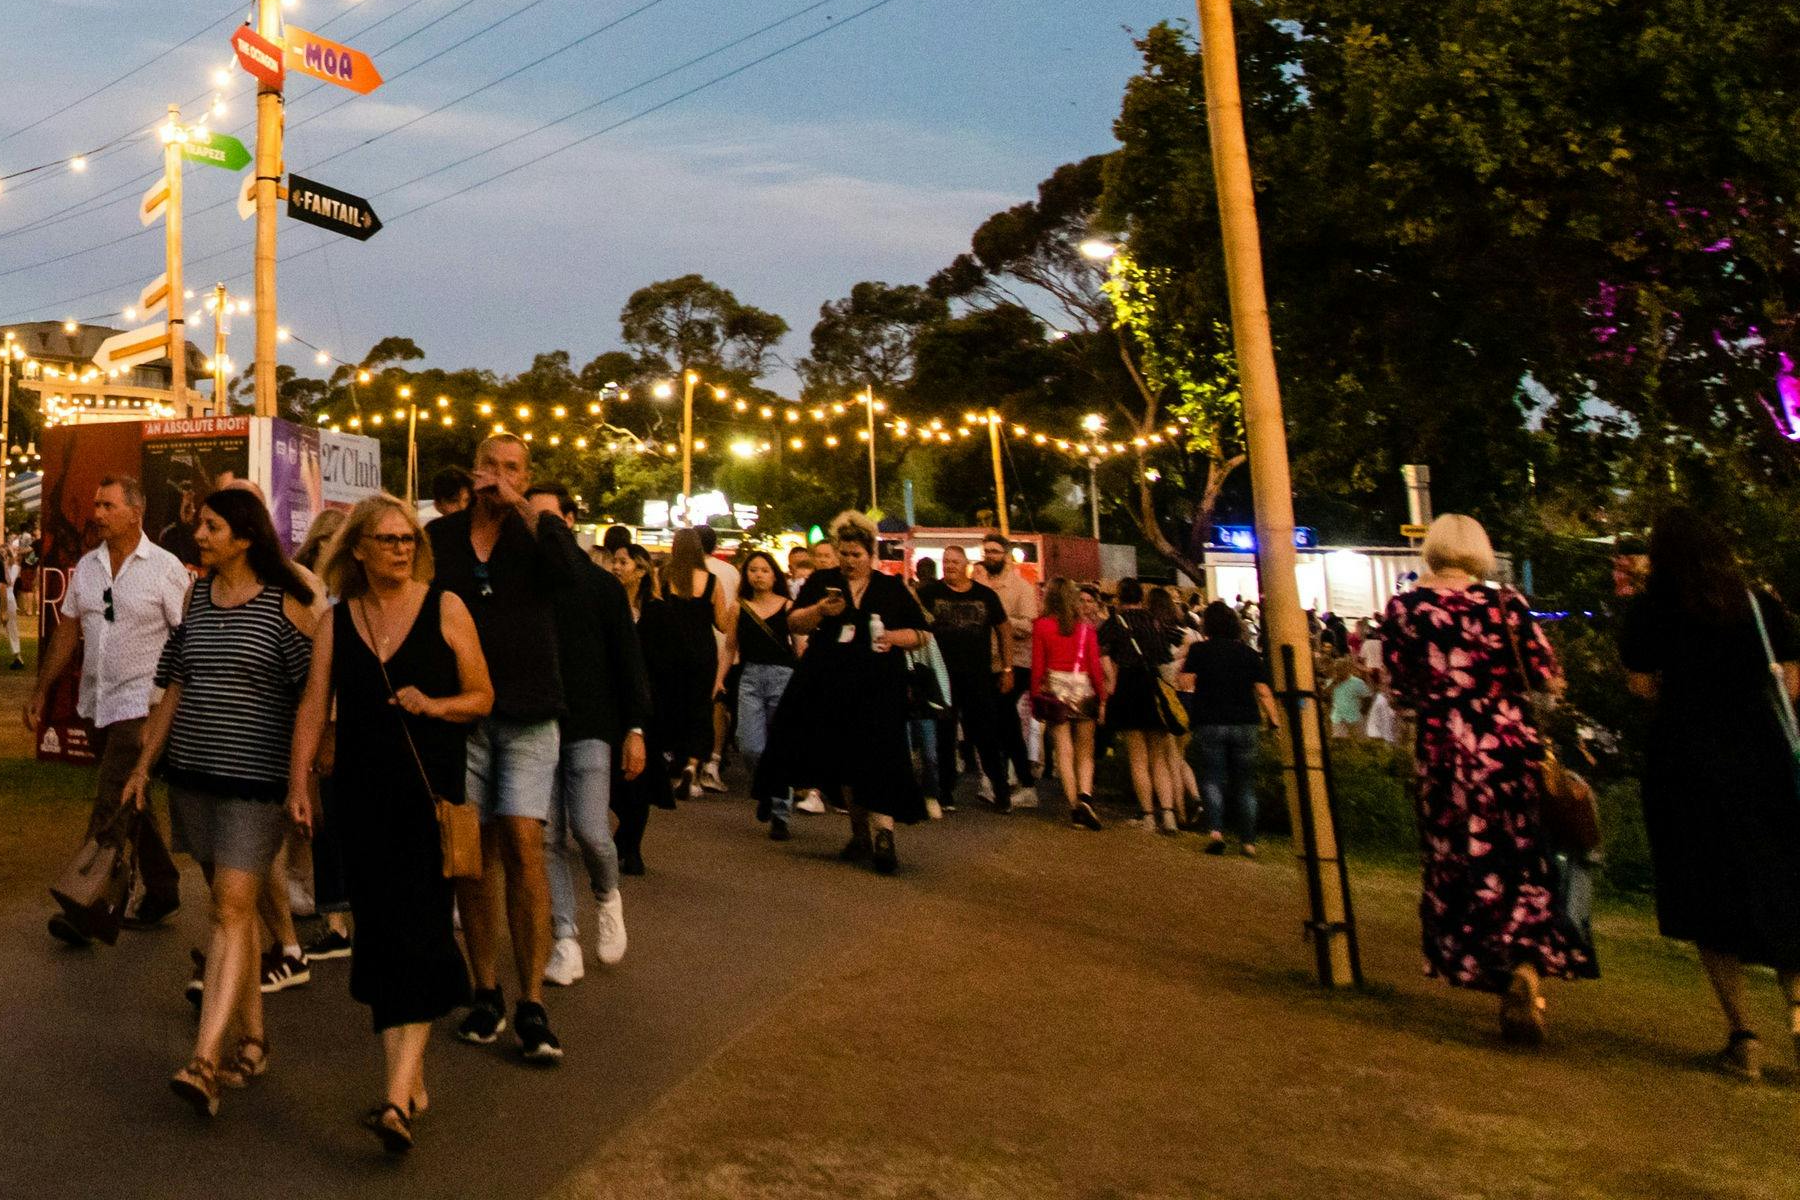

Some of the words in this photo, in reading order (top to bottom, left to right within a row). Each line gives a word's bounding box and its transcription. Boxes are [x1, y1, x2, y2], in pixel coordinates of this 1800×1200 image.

[304, 42, 352, 81] MOA
[304, 191, 362, 228] FANTAIL
[162, 419, 214, 434] ABSOLUTE
[322, 443, 340, 482] 27
[342, 447, 380, 489] Club
